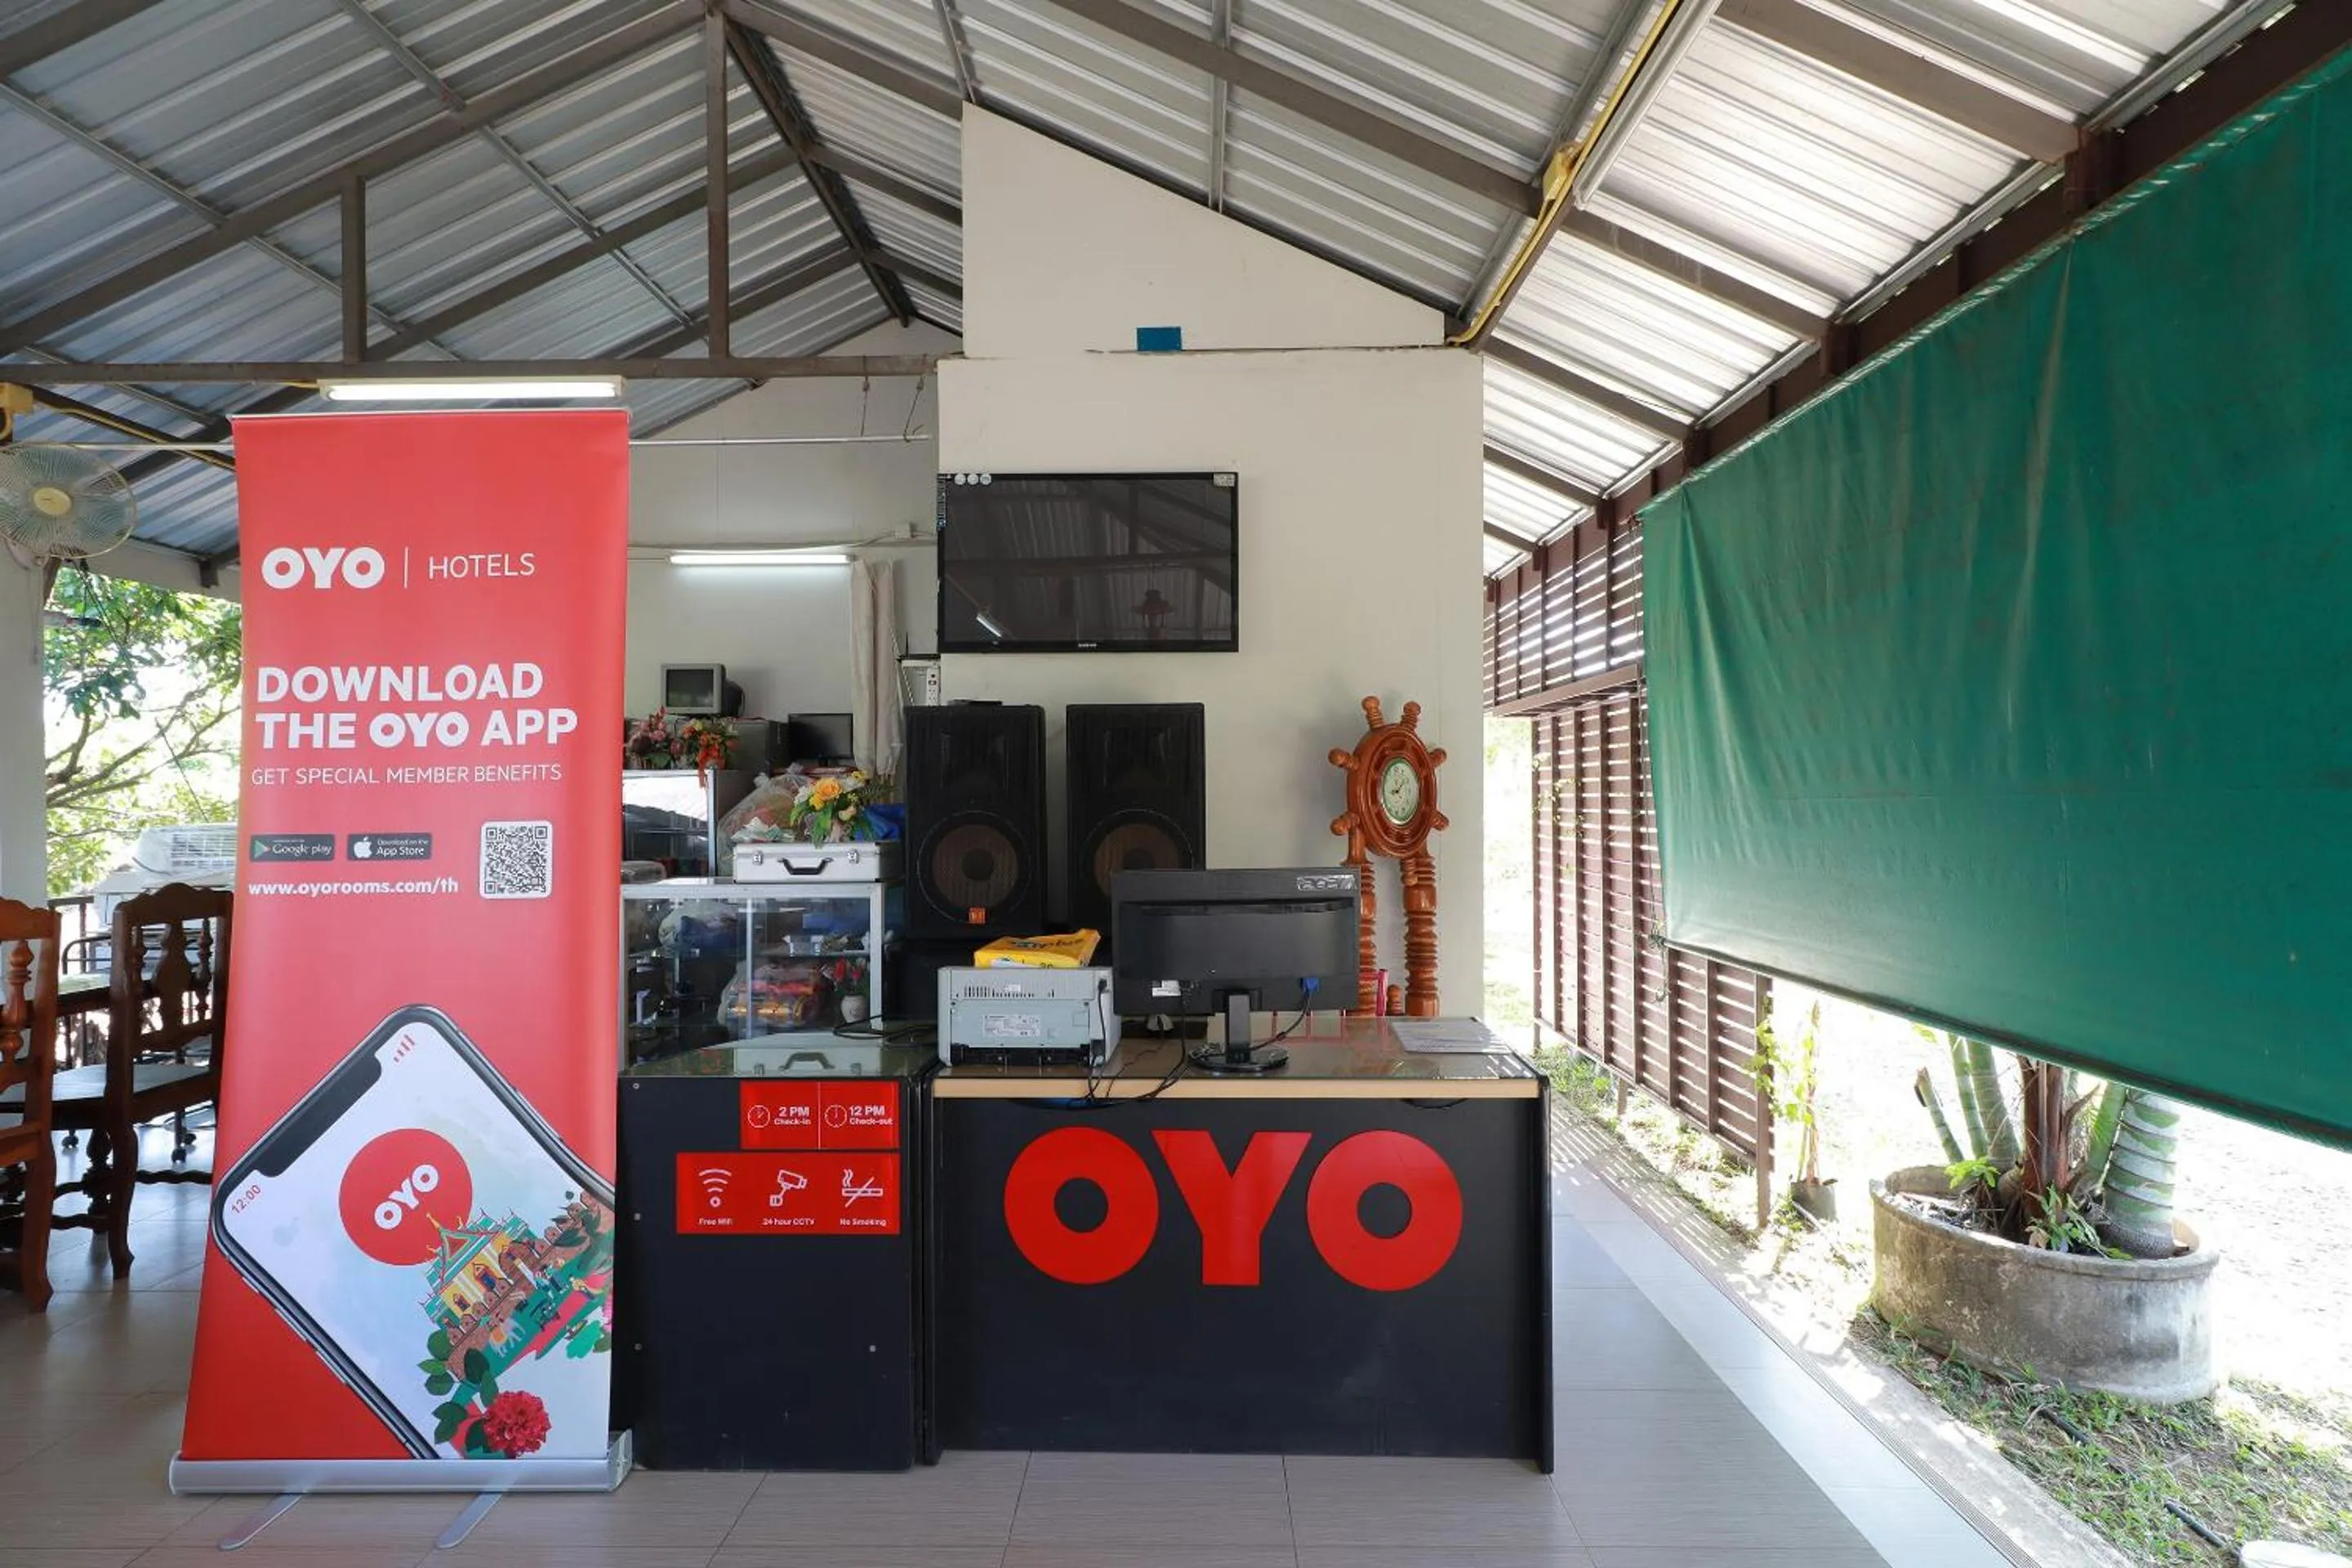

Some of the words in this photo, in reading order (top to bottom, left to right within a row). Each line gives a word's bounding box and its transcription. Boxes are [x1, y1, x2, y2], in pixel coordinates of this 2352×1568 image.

[261, 546, 385, 590] OYO
[428, 553, 536, 580] HOTELS
[256, 662, 544, 703] DOWNLOAD
[255, 712, 357, 749] THE
[369, 710, 470, 748] OYO
[480, 708, 578, 746] APP
[252, 767, 290, 786] GET
[295, 767, 380, 785] SPECIAL
[386, 766, 469, 784] MEMBER
[474, 764, 563, 783] BENEFITS
[272, 844, 307, 857] Google
[376, 846, 398, 858] App
[399, 846, 425, 856] Store
[248, 876, 460, 898] www.oyorooms.com/th
[778, 1106, 787, 1117] 2
[790, 1106, 810, 1117] PM
[849, 1105, 862, 1116] 12
[865, 1105, 885, 1116] PM
[773, 1117, 812, 1126] Check-in
[849, 1117, 893, 1126] Check-out
[231, 1184, 261, 1214] 12:00
[374, 1164, 439, 1230] OYO
[1003, 1125, 1463, 1292] OYO
[698, 1218, 716, 1226] Free
[763, 1218, 776, 1226] 24
[776, 1218, 792, 1226] hour
[792, 1218, 815, 1226] CCTV
[840, 1218, 851, 1226] No
[853, 1218, 887, 1227] Smoking
